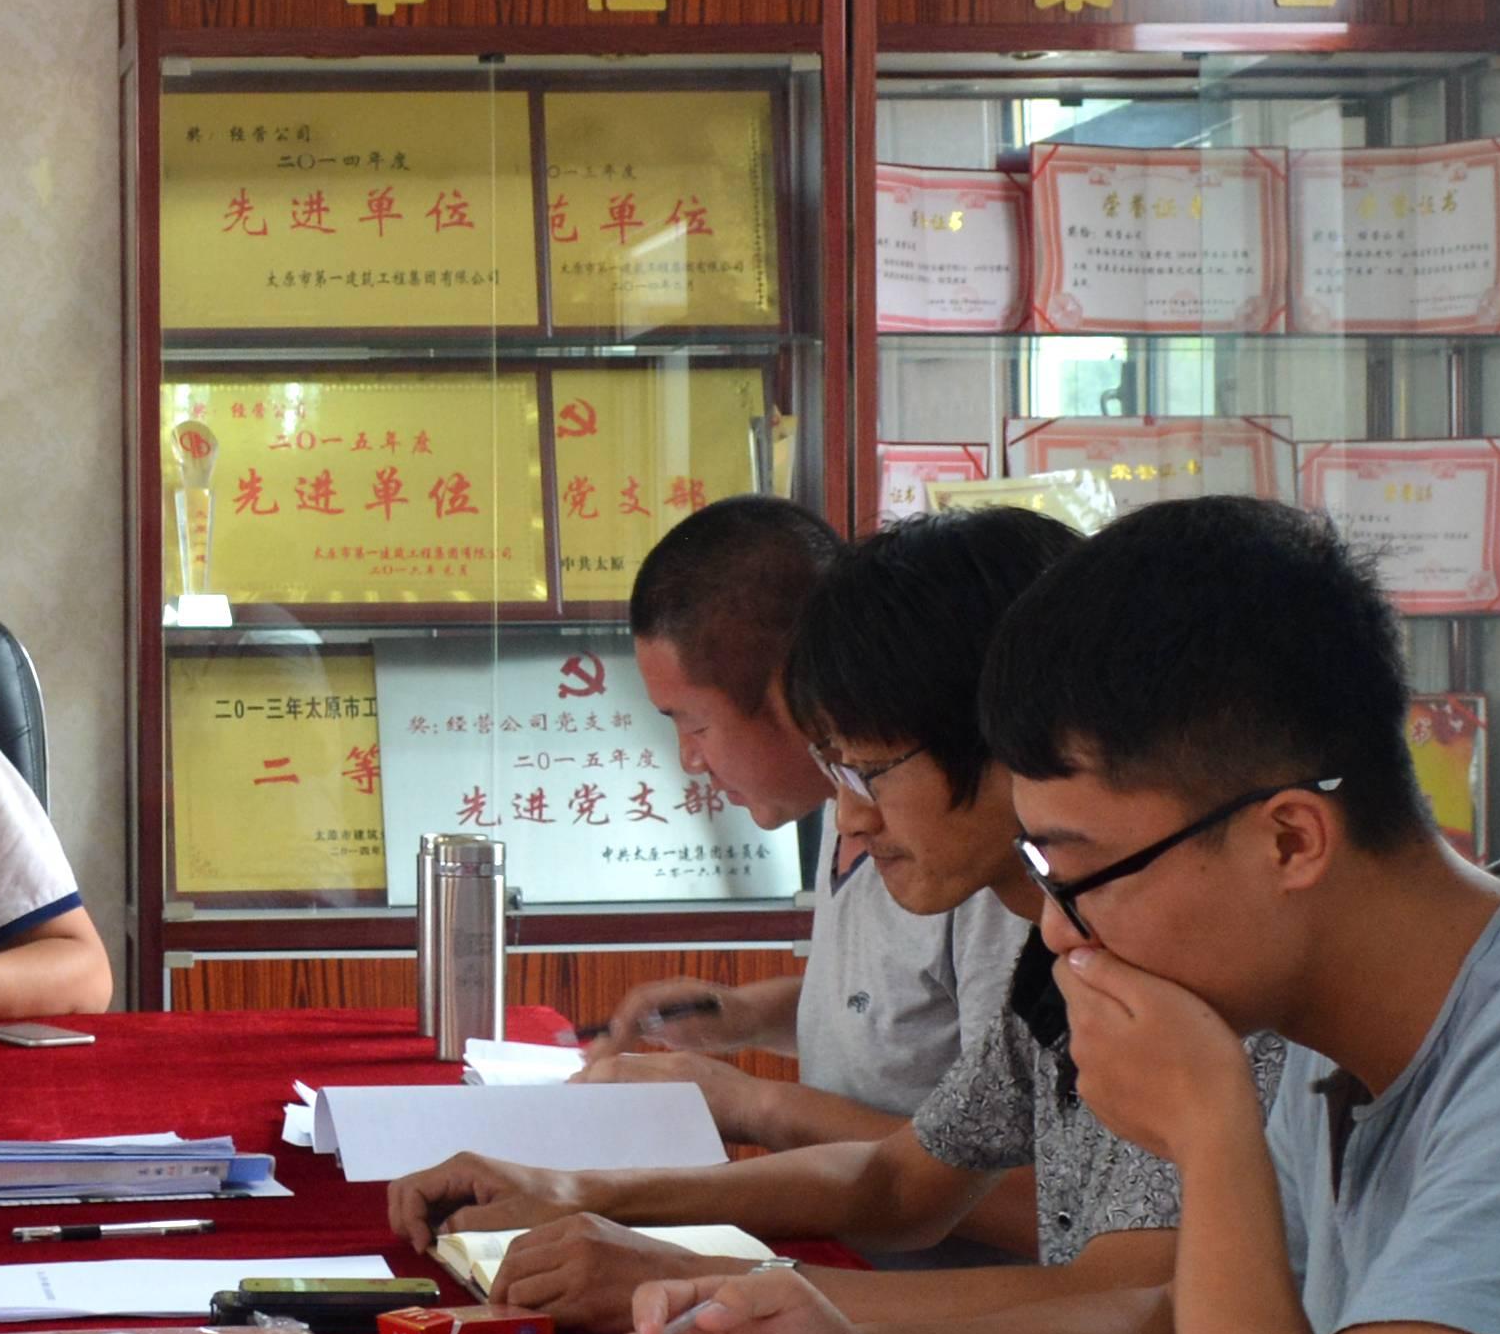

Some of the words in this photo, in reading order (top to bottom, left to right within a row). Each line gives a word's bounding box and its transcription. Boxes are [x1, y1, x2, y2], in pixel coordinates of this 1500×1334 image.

[222, 186, 475, 237] 先进单位
[232, 467, 480, 521] 先进单位
[563, 475, 708, 518] 党支部
[456, 781, 726, 827] 先进党支部
